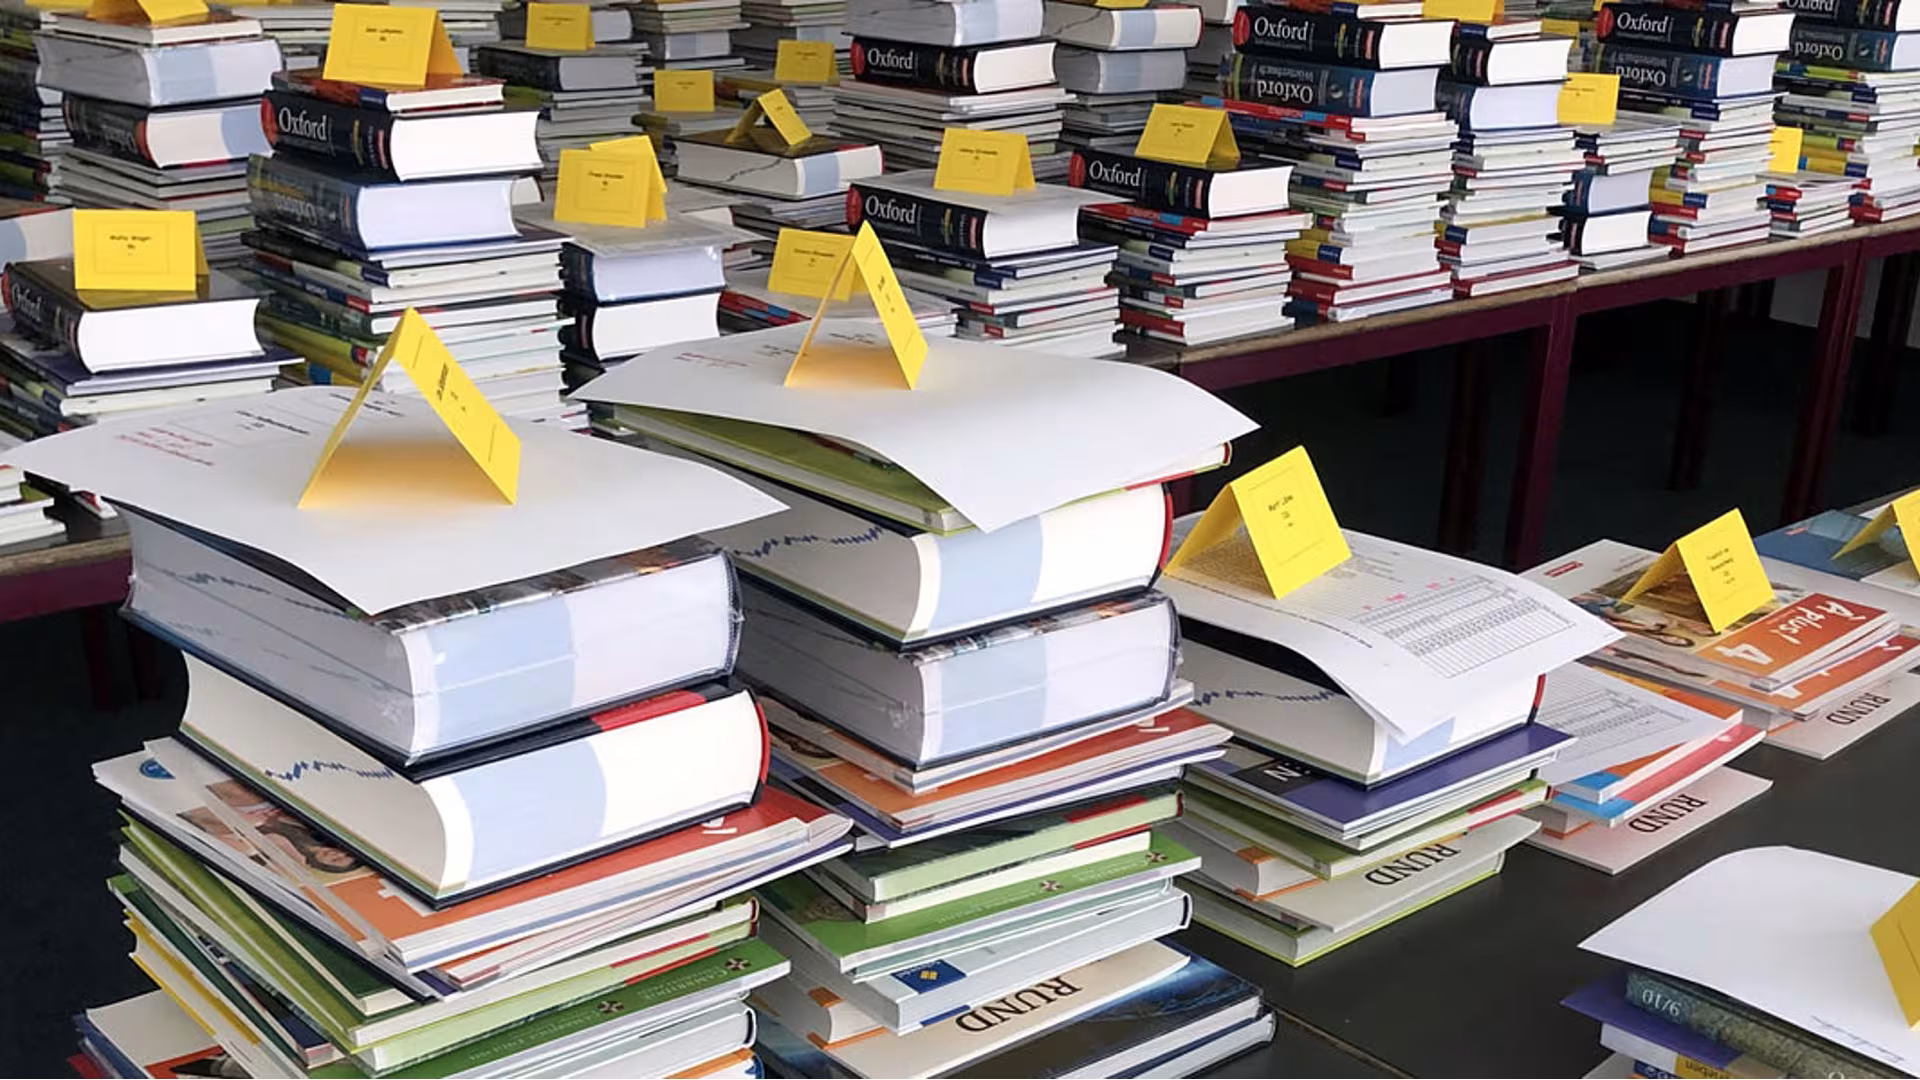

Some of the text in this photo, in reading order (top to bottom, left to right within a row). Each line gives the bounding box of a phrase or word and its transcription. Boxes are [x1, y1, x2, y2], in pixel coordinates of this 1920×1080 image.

[1254, 16, 1309, 41] Oxford
[1617, 12, 1669, 33] Oxford
[867, 48, 914, 70] Oxford
[1795, 42, 1843, 60] Oxford
[1615, 66, 1666, 87] Oxford
[1257, 79, 1314, 104] Oxford
[279, 106, 328, 141] Oxford
[1089, 160, 1142, 187] Oxford
[865, 195, 917, 224] Oxford
[12, 282, 42, 322] Oxford
[1768, 607, 1826, 645] plus!
[1715, 643, 1774, 666] 4
[1826, 692, 1891, 725] RUND
[1628, 794, 1707, 833] RUND
[1365, 843, 1461, 885] RUND
[955, 976, 1083, 1032] RUND
[1642, 988, 1682, 1017] 9/10
